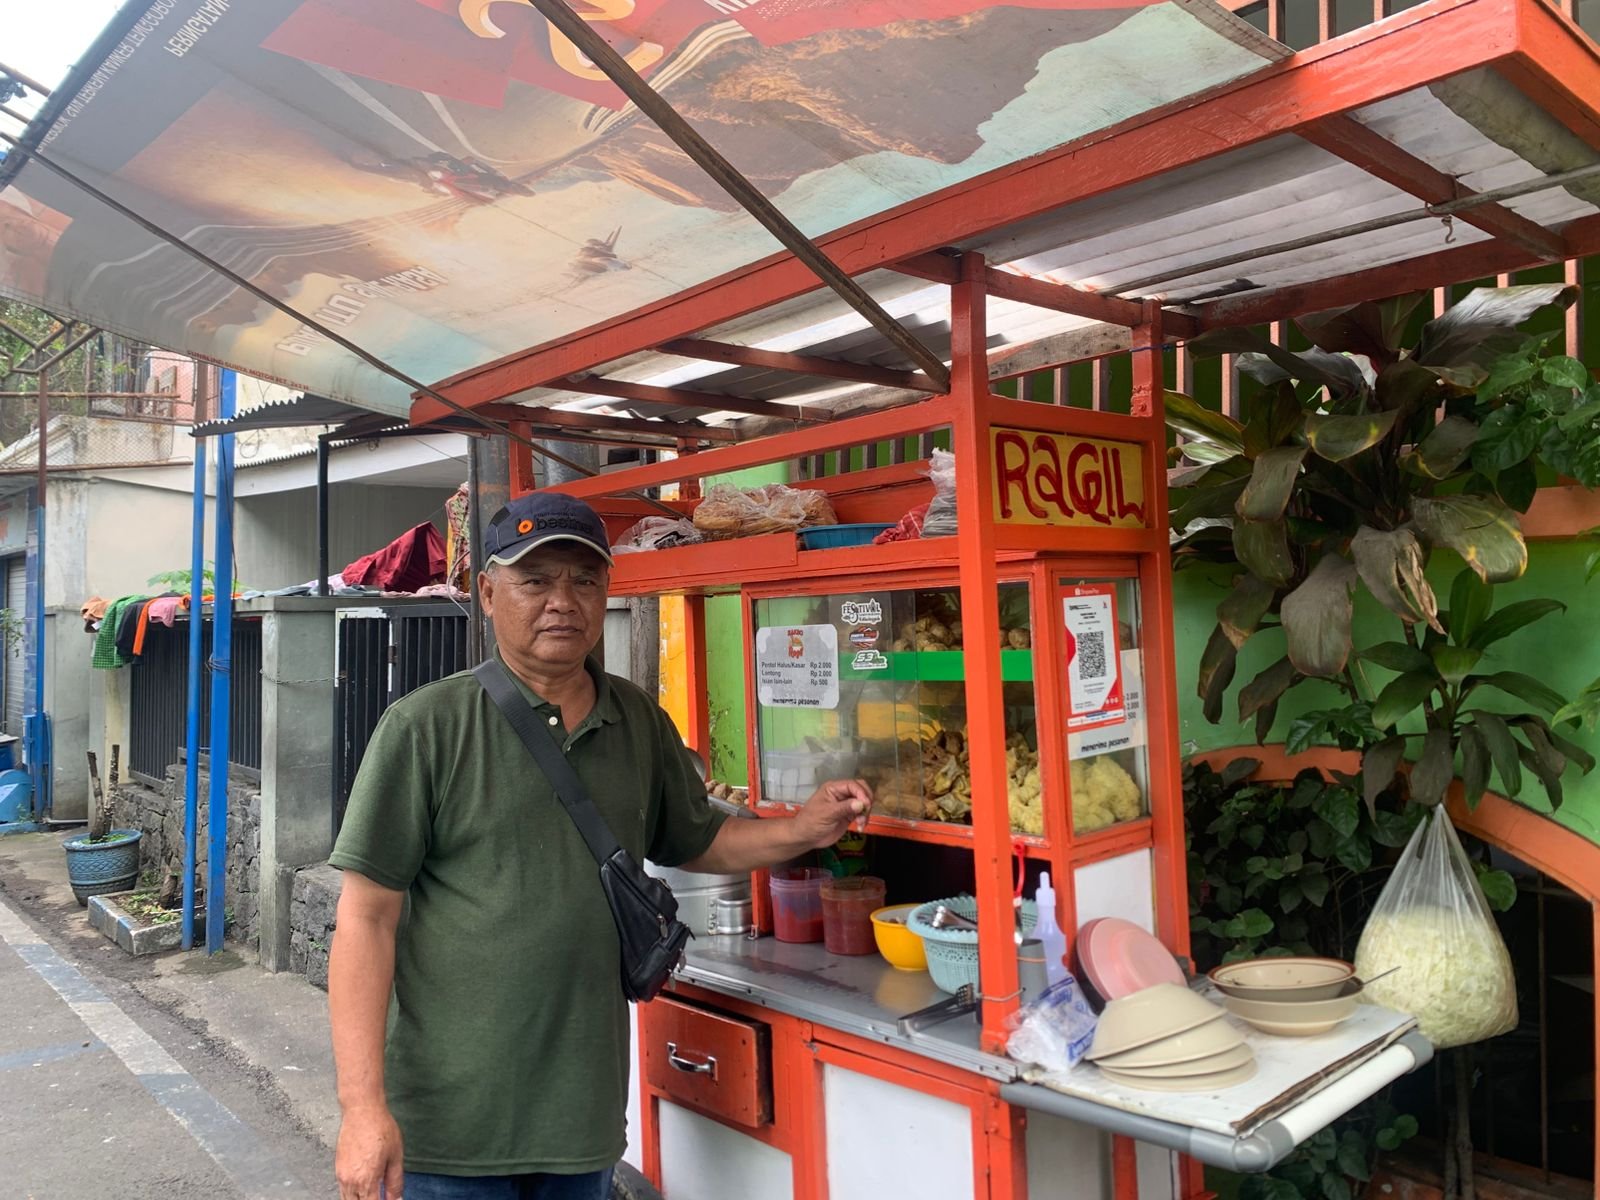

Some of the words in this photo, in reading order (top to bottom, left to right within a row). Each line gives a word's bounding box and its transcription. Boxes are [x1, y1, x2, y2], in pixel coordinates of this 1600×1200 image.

[810, 678, 818, 686] Rp
[1081, 740, 1108, 753] menerima
[1108, 737, 1130, 749] pesanan
